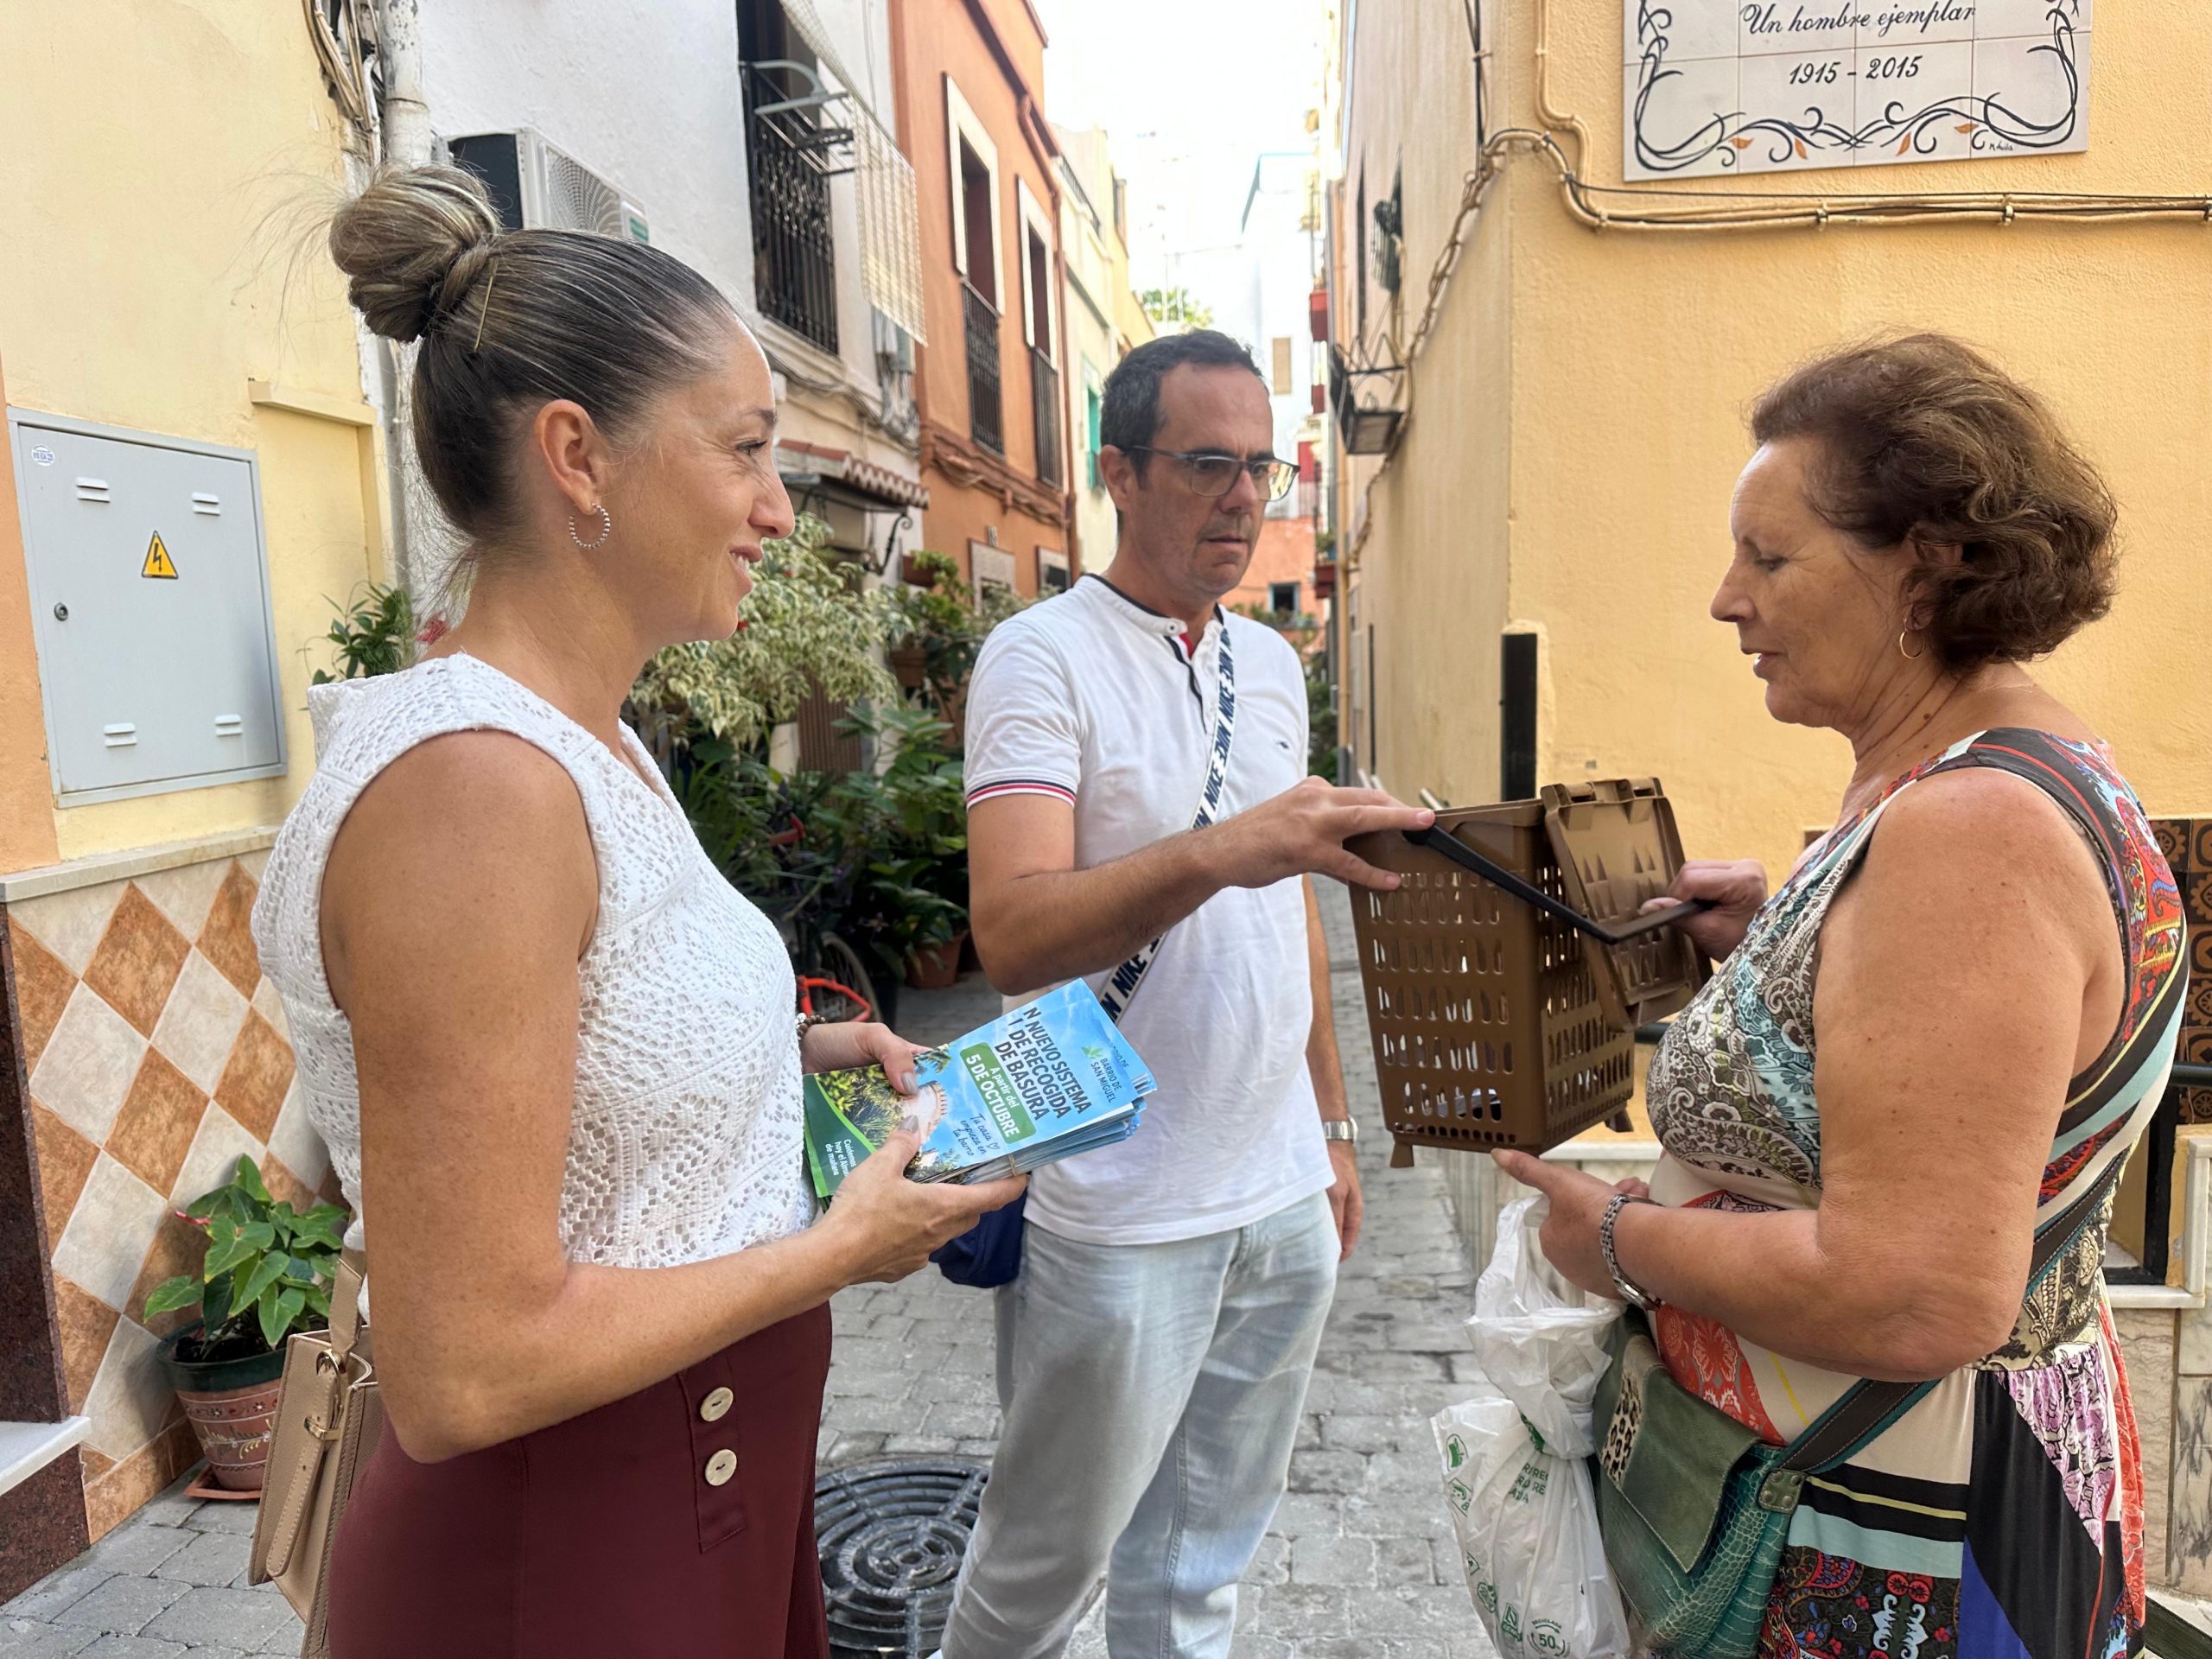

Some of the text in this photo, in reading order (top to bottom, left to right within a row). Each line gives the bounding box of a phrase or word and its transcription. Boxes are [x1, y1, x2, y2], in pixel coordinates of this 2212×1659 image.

[1739, 0, 1975, 37] Un hombre ejemplar
[1789, 61, 1840, 84] 1915
[1866, 55, 1923, 79] 2015
[1218, 679, 1235, 724] NIKE
[1214, 719, 1231, 767] NIKE
[1204, 760, 1224, 811] NIKE
[1112, 954, 1147, 999] NIKE
[995, 1041, 1017, 1061] DE
[1006, 1059, 1051, 1121] BASURA
[1008, 1029, 1071, 1119] DE RECOGIDA
[1025, 1020, 1092, 1114] NUEVO SISTEMA
[1090, 1061, 1116, 1103] SAN MIGUEL
[1100, 1058, 1122, 1091] BARRIO DE
[966, 1054, 1020, 1137] 5 DE OCTUBRE
[992, 1073, 1012, 1095] partir
[1006, 1093, 1020, 1108] del
[825, 1143, 833, 1152] de
[961, 1121, 987, 1154] empieza en
[969, 1113, 992, 1141] Tu casa
